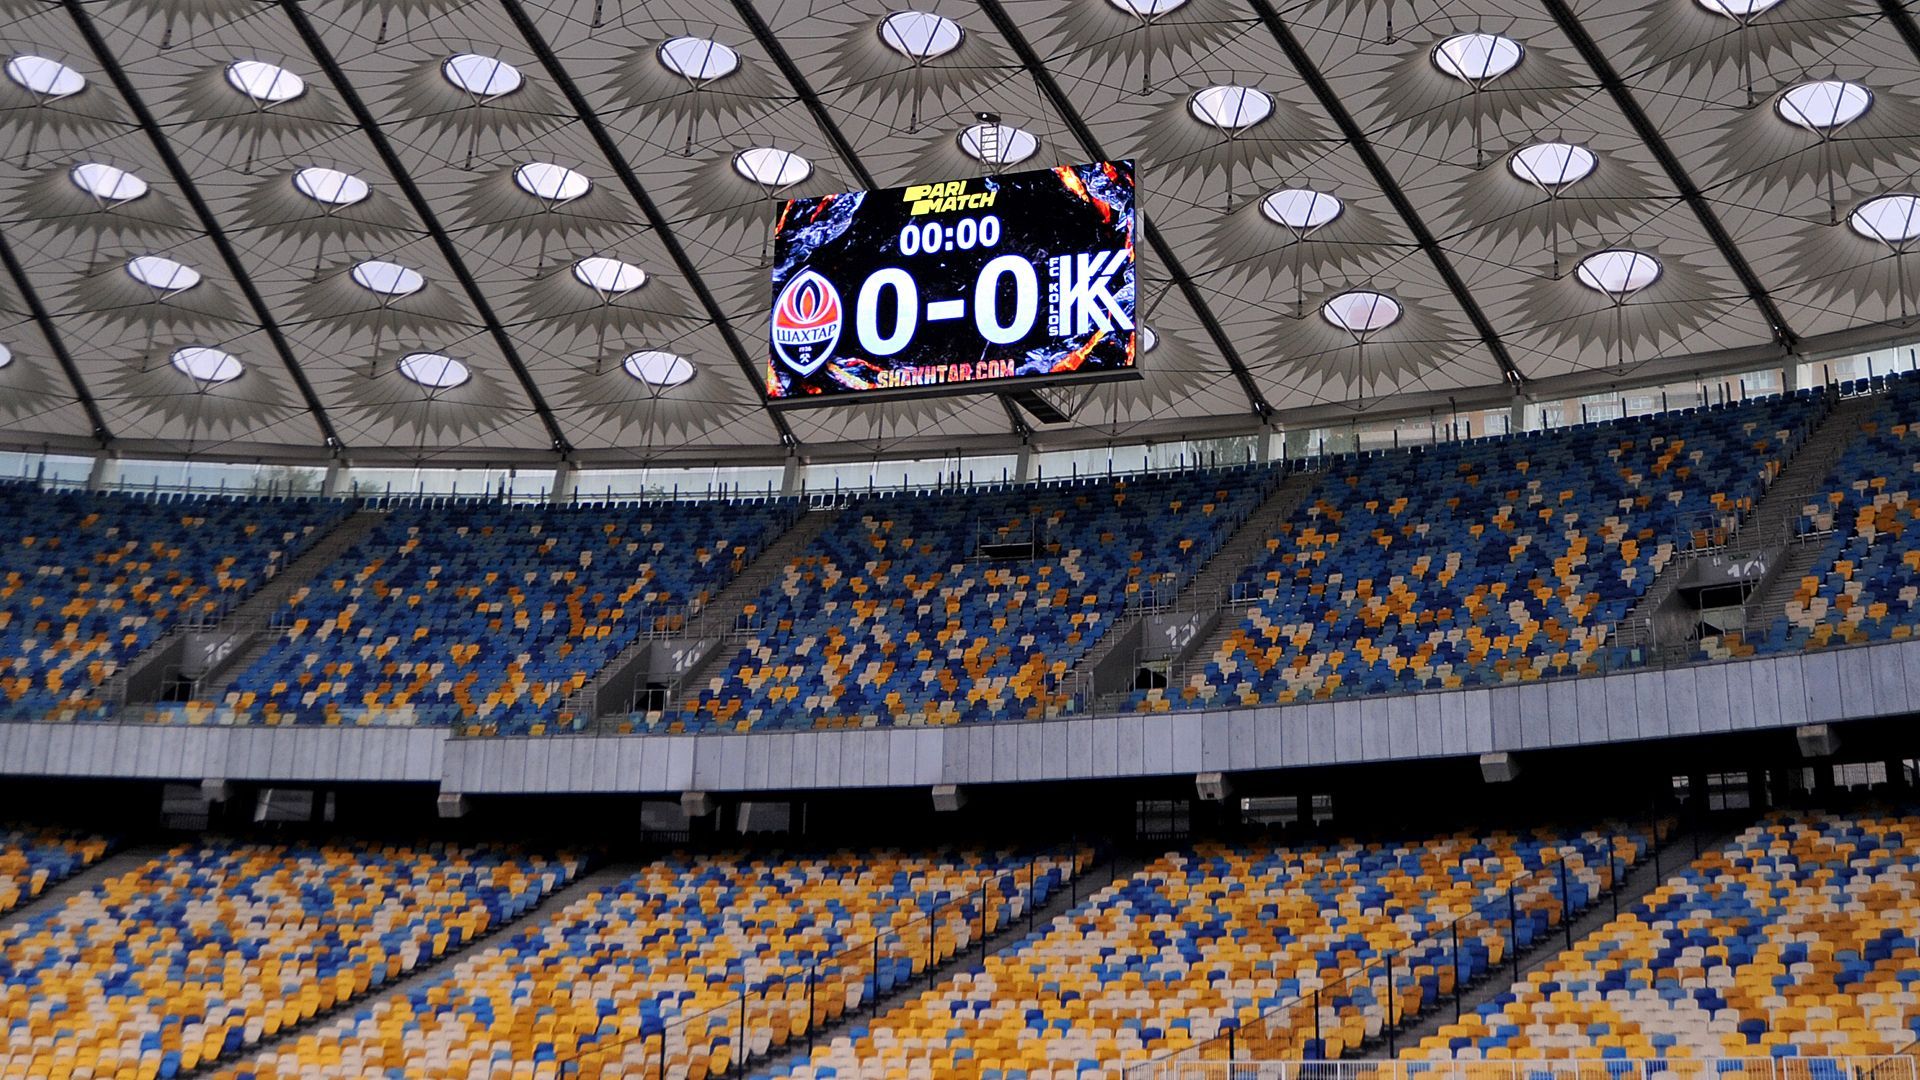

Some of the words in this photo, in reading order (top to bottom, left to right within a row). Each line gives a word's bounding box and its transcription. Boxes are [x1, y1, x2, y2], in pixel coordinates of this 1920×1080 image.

[903, 180, 967, 202] PARI
[911, 191, 997, 215] MATCH
[900, 216, 1000, 256] 00:00
[1049, 257, 1060, 277] FC
[1048, 282, 1059, 336] KOLOS
[777, 324, 837, 342] ШАХТАР
[877, 360, 1014, 388] SHAKHTAR.COM
